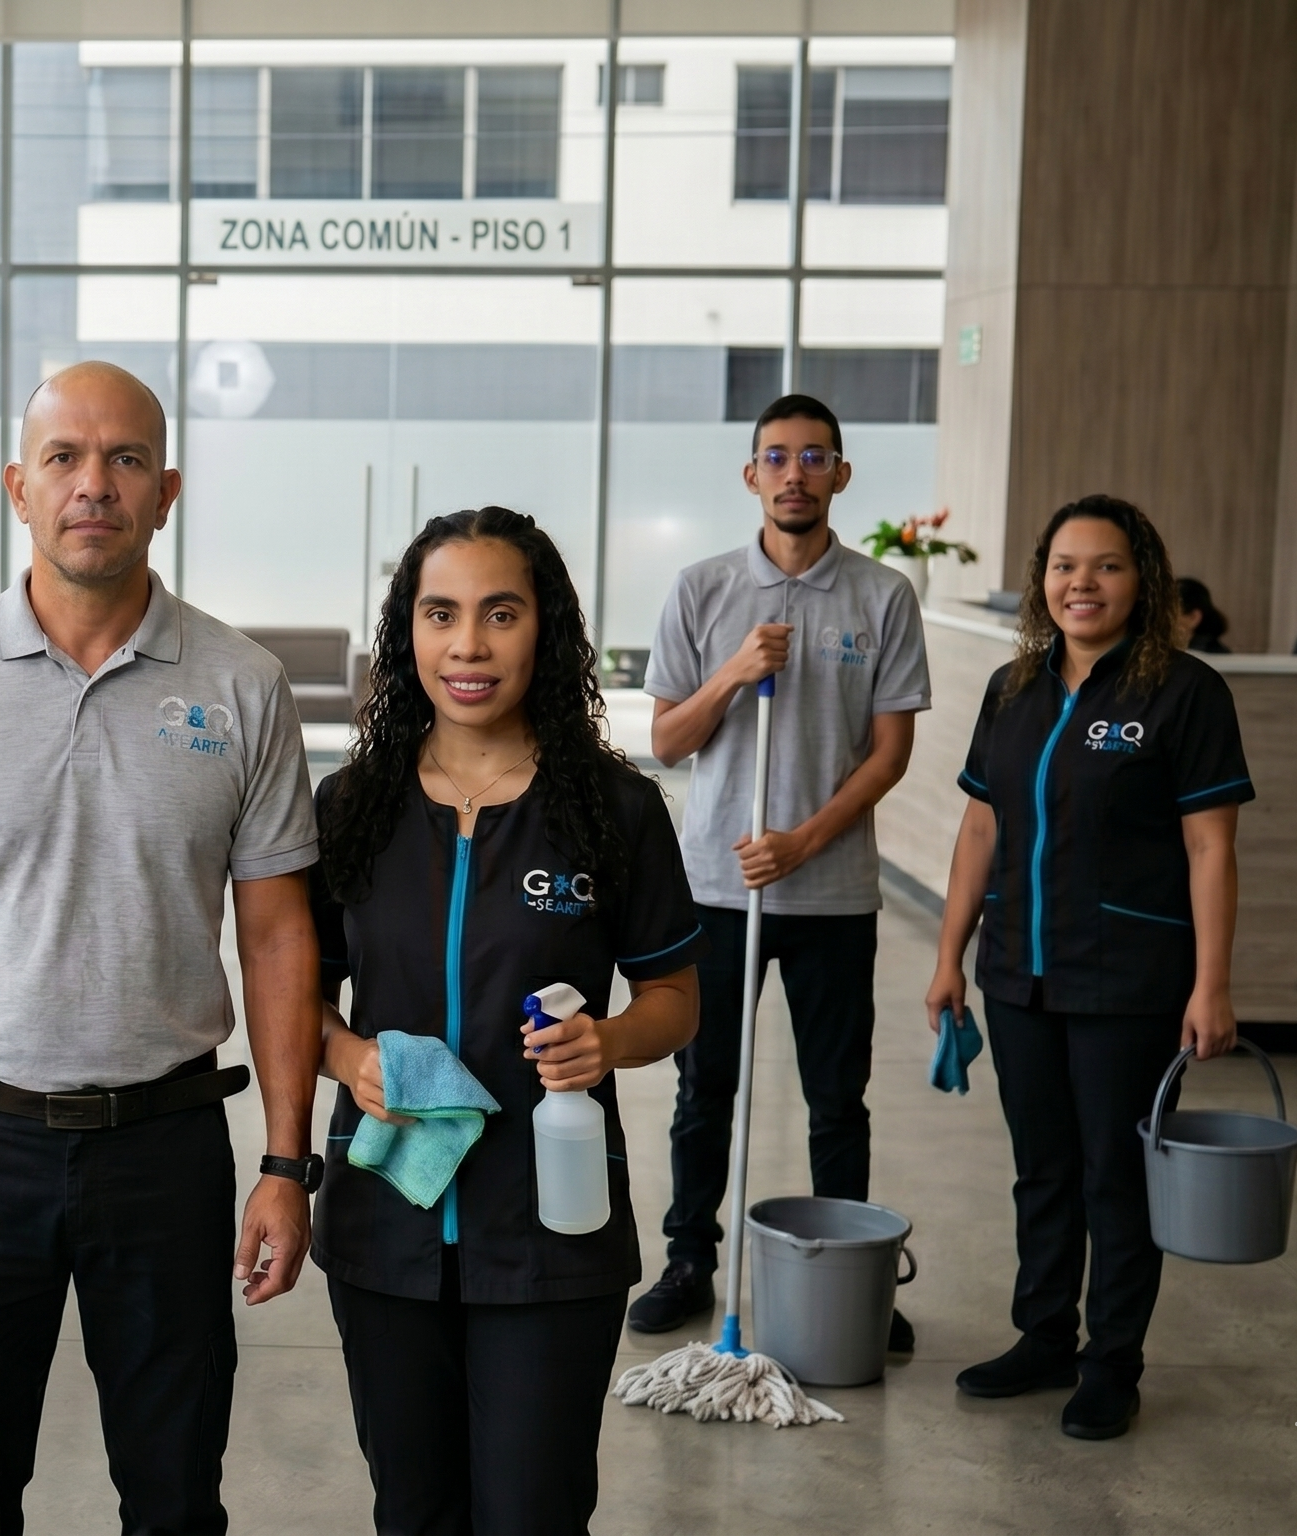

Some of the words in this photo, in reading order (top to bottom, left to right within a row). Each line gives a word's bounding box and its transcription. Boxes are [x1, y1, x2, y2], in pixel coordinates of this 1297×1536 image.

[219, 219, 310, 251] ZONA
[320, 211, 439, 251] COMÚN
[471, 219, 547, 251] PISO
[558, 219, 572, 251] 1
